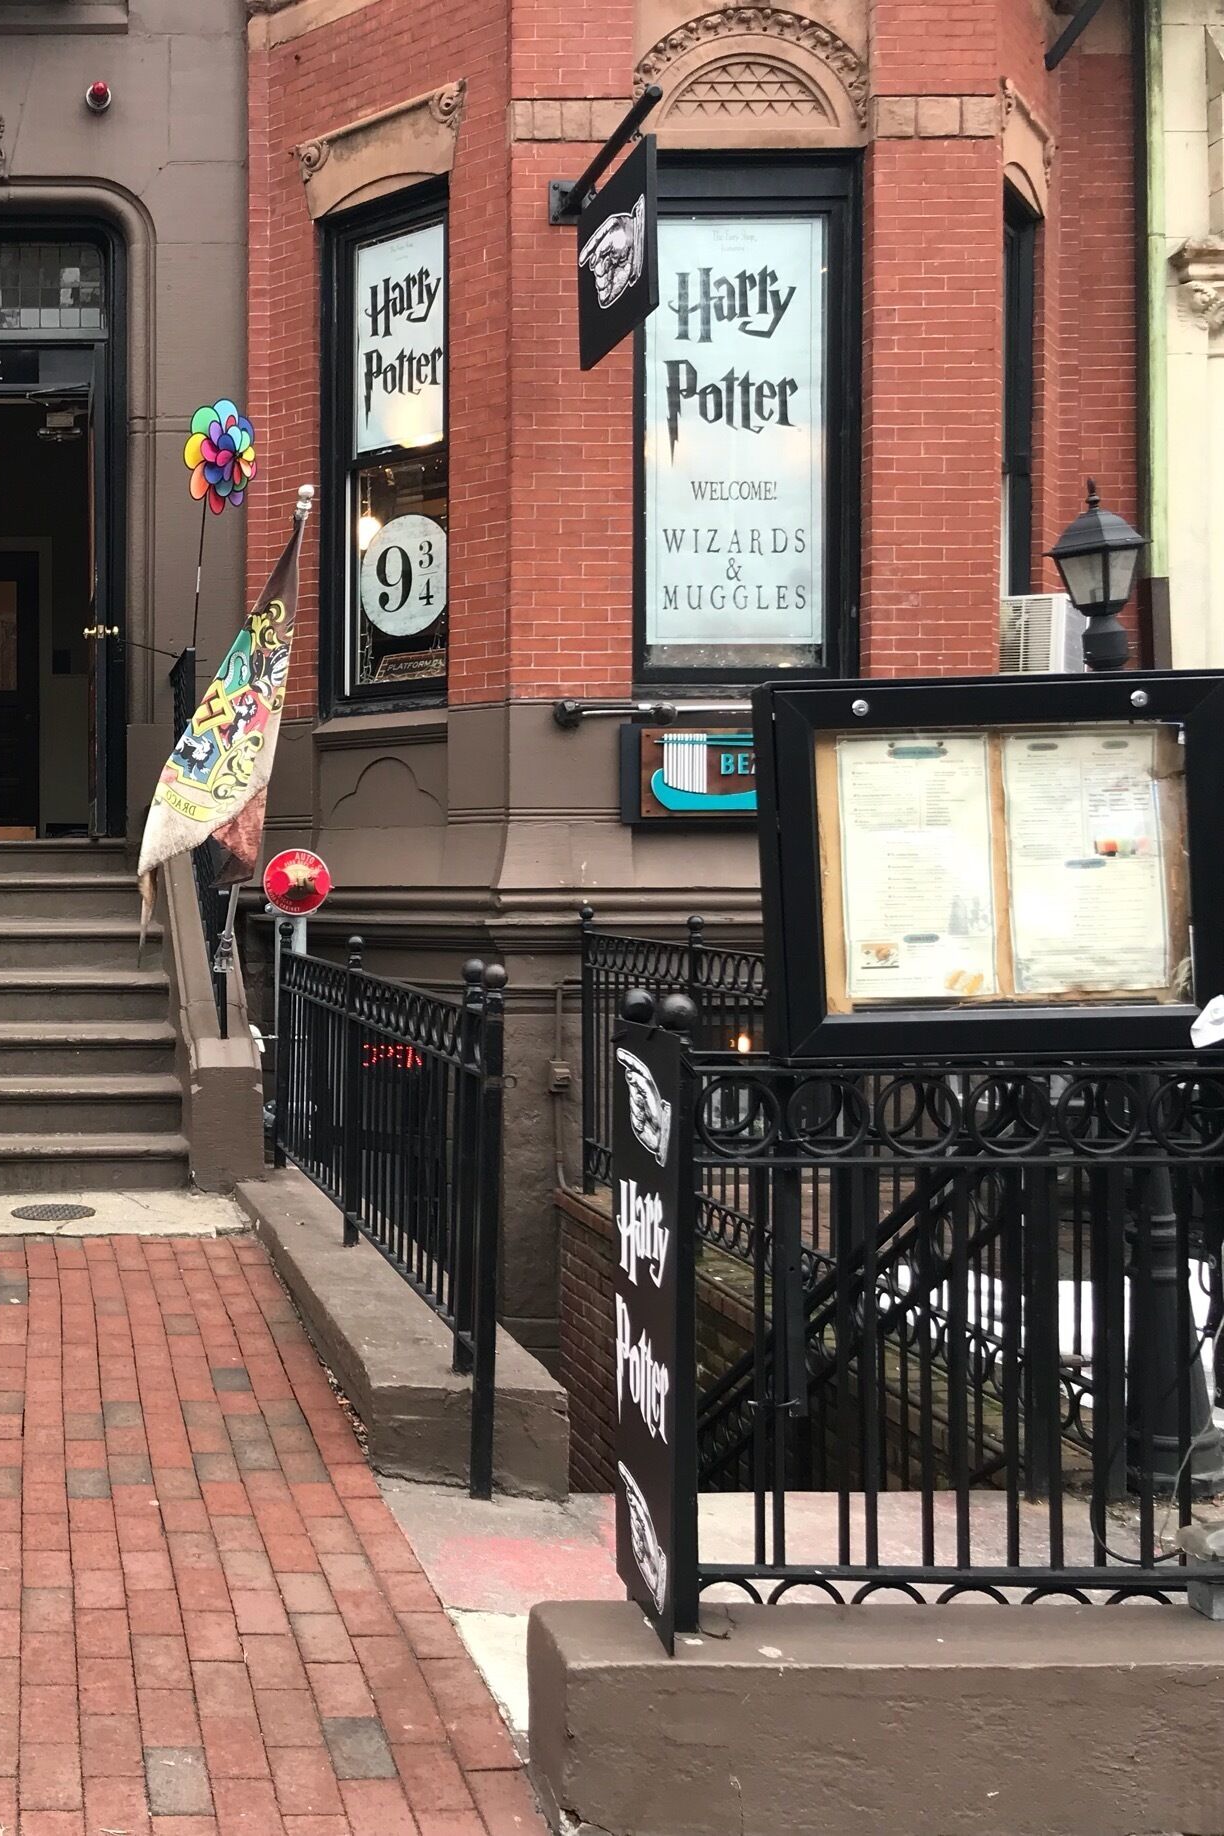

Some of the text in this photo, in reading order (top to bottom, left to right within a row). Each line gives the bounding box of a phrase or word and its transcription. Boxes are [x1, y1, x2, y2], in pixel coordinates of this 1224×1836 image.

[364, 265, 442, 338] Harry
[667, 264, 797, 343] Harry
[363, 346, 443, 430] Potter
[663, 359, 799, 468] Potter
[690, 480, 778, 501] WELCOME!
[662, 527, 807, 556] WIZARDS
[726, 557, 743, 582] &
[376, 544, 413, 614] 9
[662, 584, 807, 611] MUGGLES
[616, 1178, 670, 1289] Harry
[615, 1292, 670, 1445] Potter
